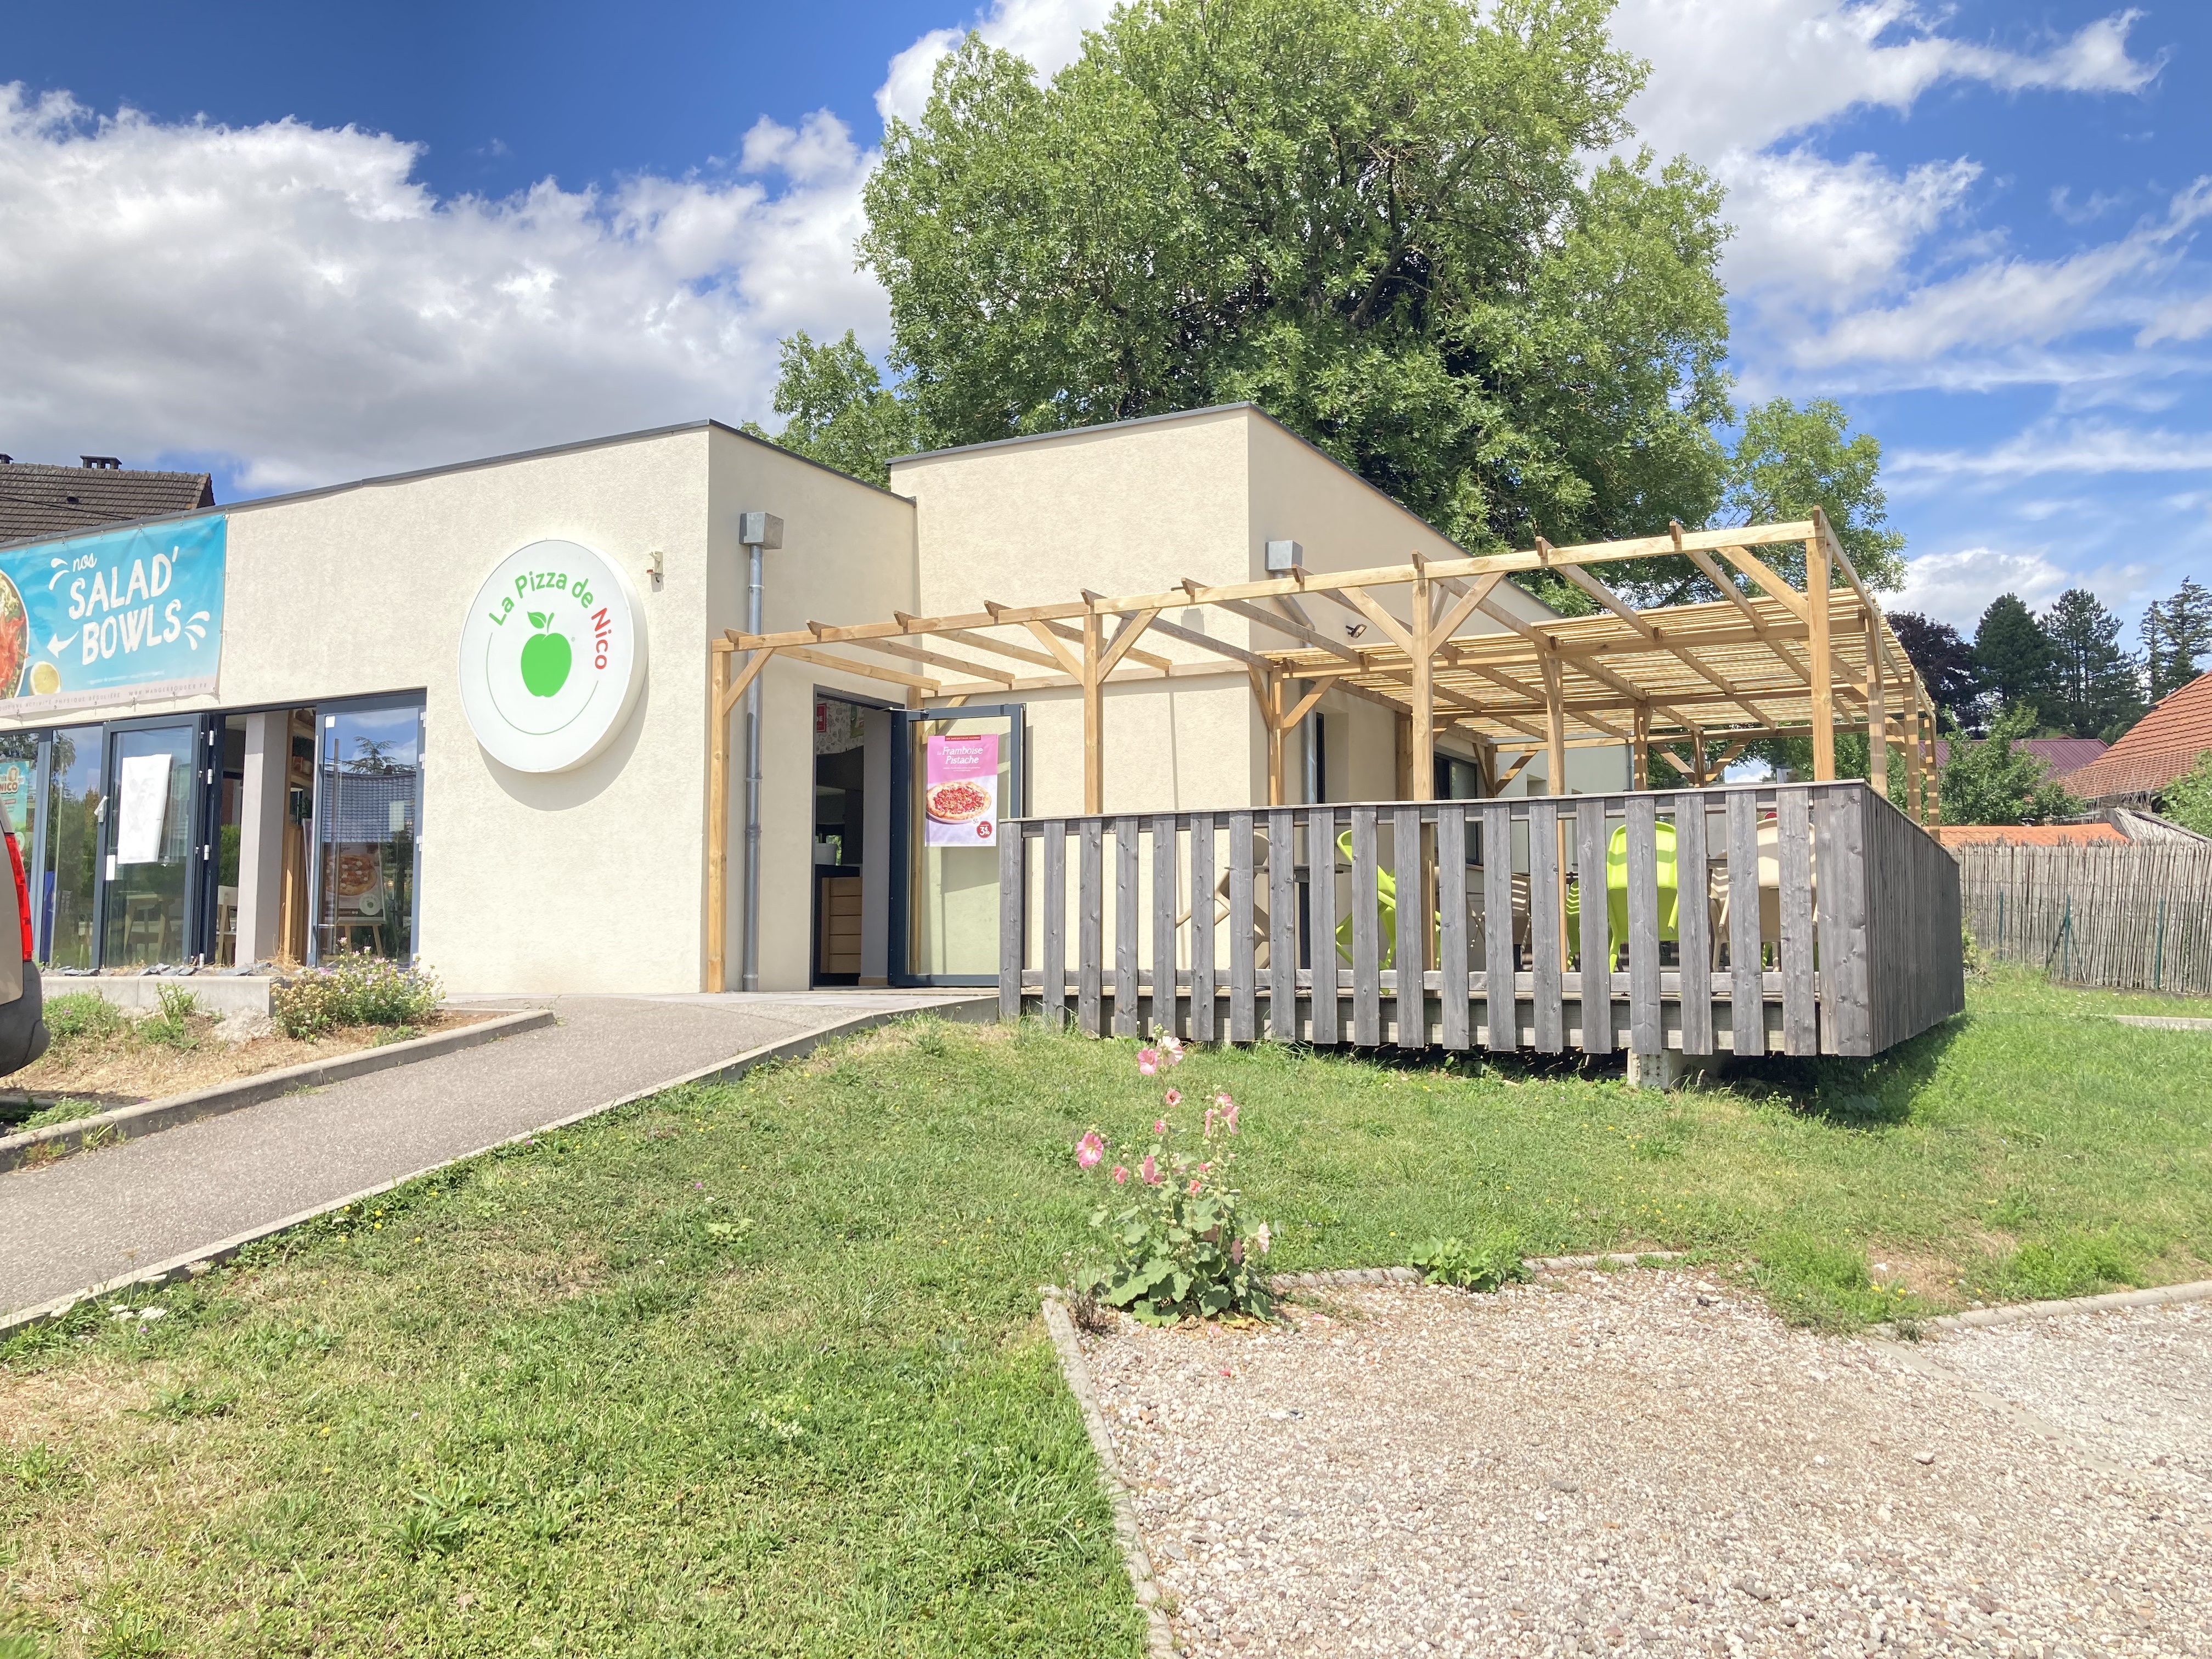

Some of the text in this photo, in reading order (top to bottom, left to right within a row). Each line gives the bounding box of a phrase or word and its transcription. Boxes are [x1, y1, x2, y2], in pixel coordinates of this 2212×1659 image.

[69, 546, 179, 619] SALAD'
[72, 552, 97, 572] nos
[82, 599, 181, 665] BOWLS
[489, 571, 612, 669] La Pizza de Nico
[942, 746, 983, 755] Framboise
[945, 755, 979, 764] Pistache
